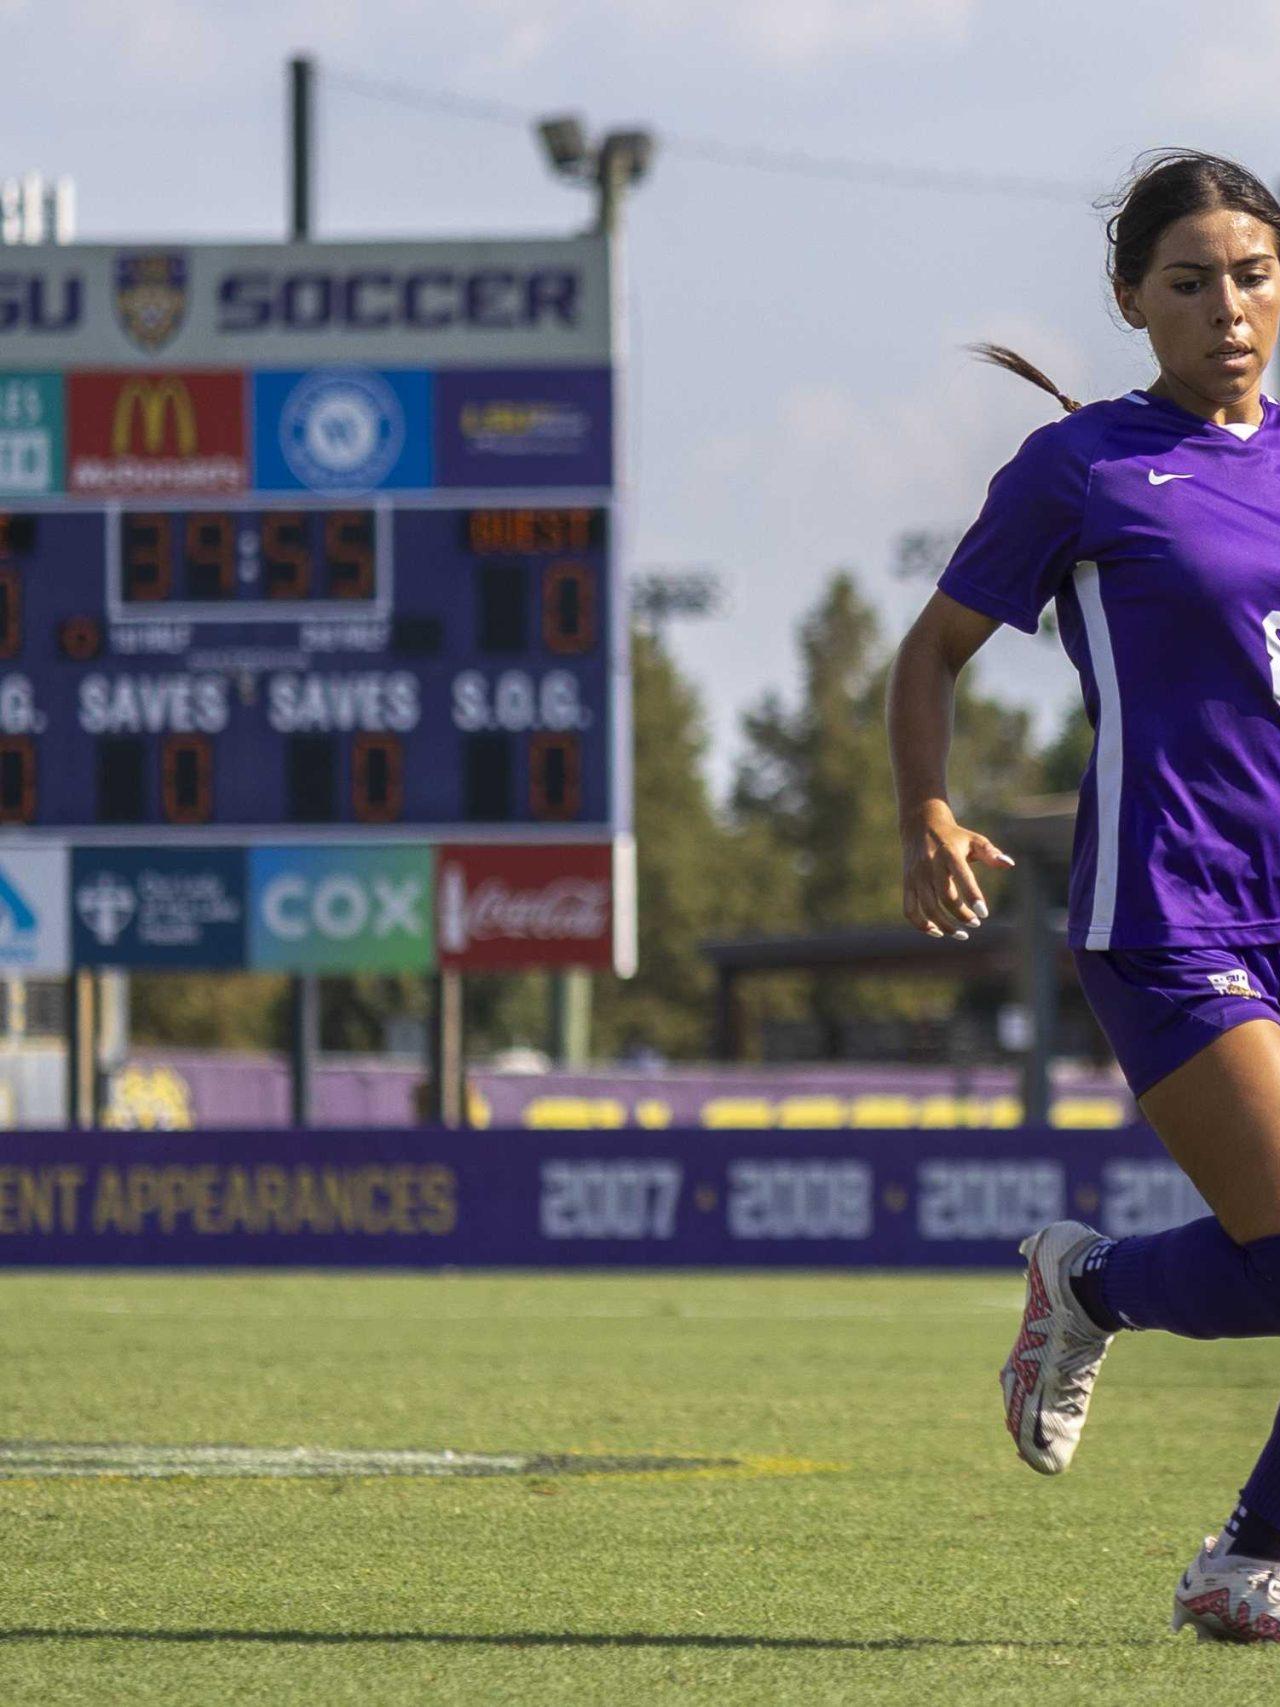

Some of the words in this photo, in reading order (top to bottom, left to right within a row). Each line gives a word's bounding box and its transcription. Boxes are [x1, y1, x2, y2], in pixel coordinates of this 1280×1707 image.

[216, 266, 584, 334] SOCCER
[541, 560, 595, 655] 0
[79, 672, 229, 733] SAVES
[268, 672, 420, 733] SAVES
[451, 671, 594, 732] S.O.G.
[162, 732, 213, 824] 0
[351, 732, 403, 824] 0
[529, 732, 581, 824] 0
[262, 872, 425, 942] COX
[94, 1164, 457, 1236] APPEARANCES
[538, 1160, 683, 1240] 2007
